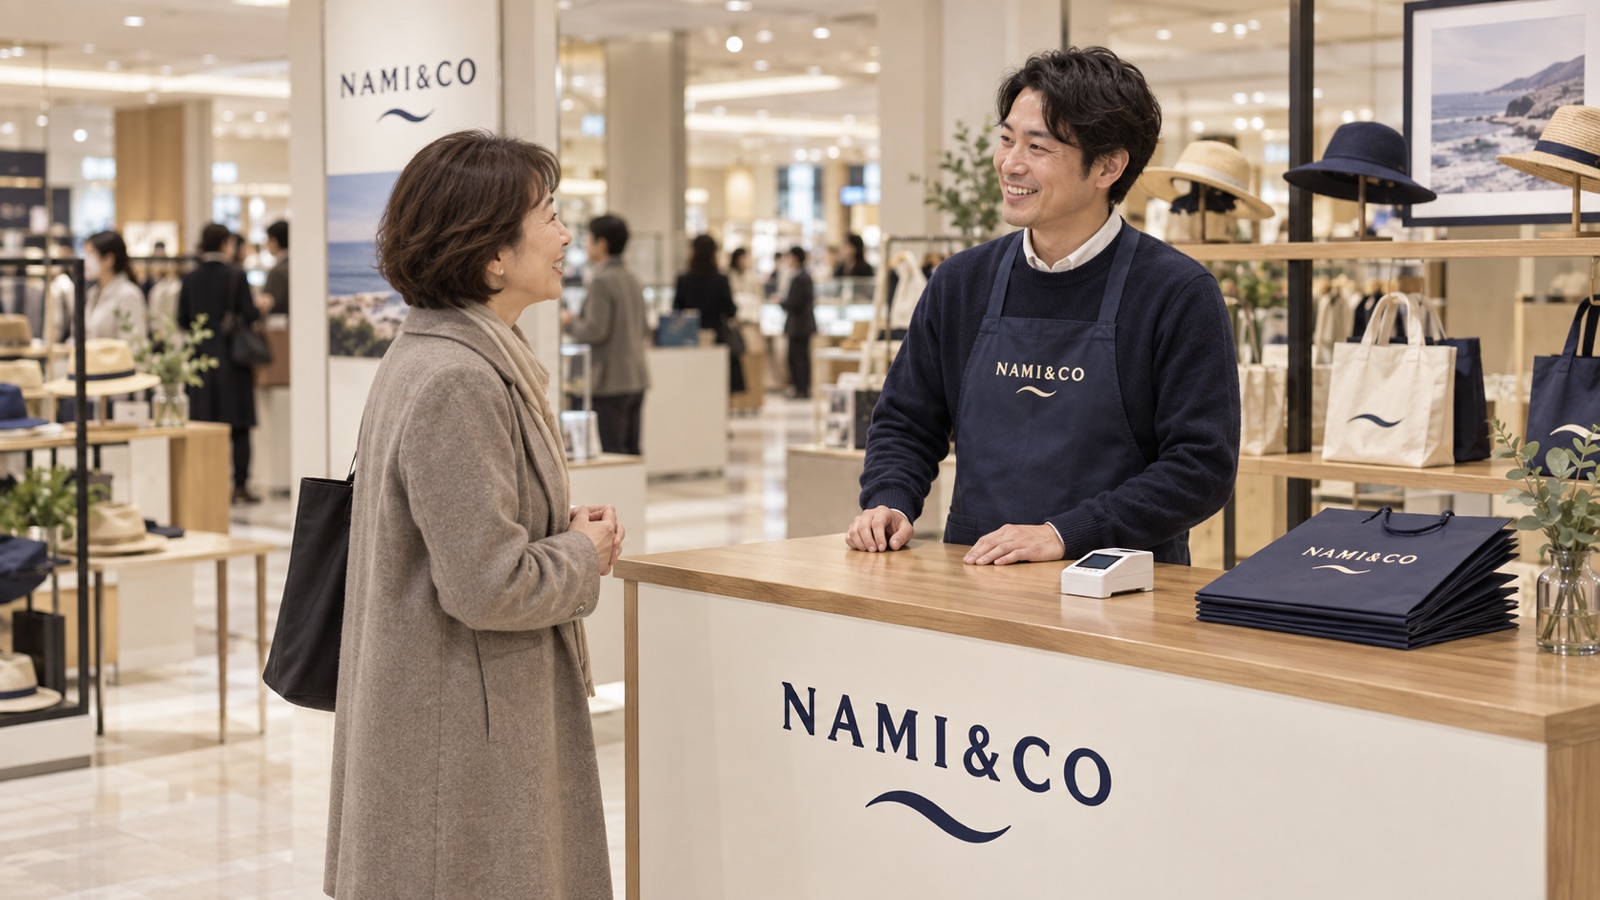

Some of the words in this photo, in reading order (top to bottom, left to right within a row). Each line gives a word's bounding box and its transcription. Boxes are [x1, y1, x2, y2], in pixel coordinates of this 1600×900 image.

[340, 57, 477, 98] NAMI&CO
[995, 361, 1085, 382] NAMI&CO
[1301, 546, 1419, 565] NAMI&CO
[781, 681, 1113, 807] NAMI&CO
